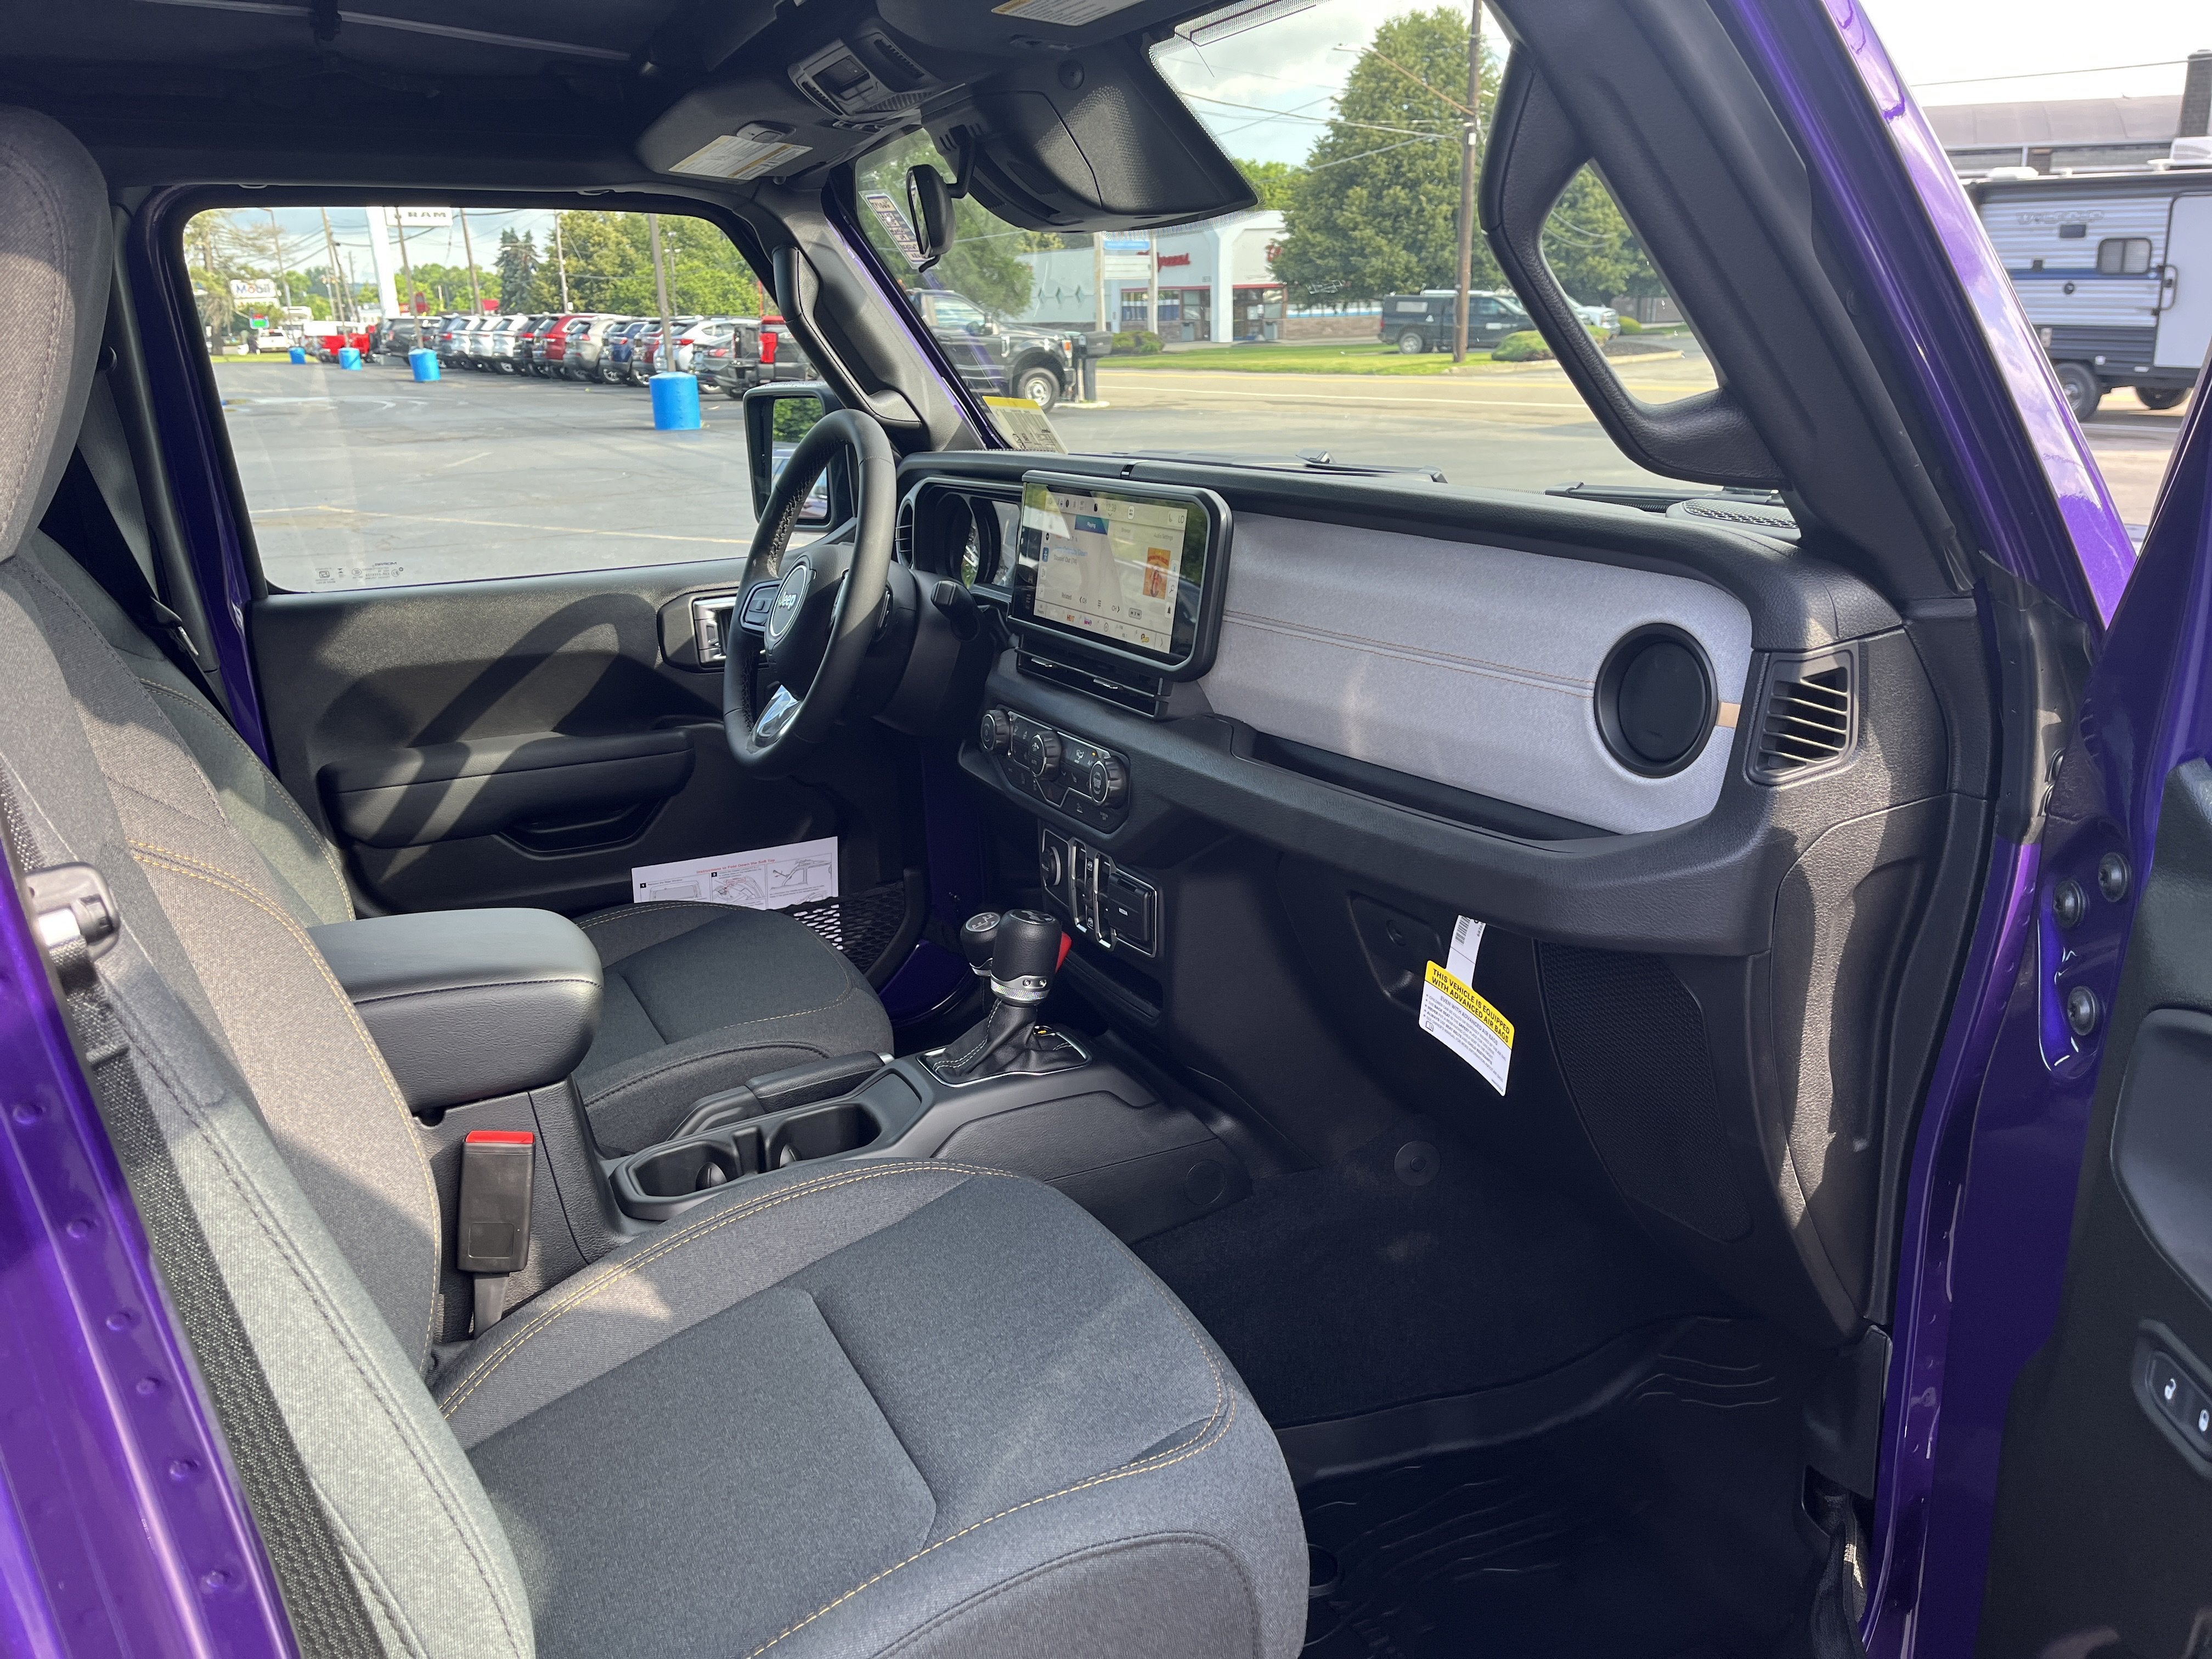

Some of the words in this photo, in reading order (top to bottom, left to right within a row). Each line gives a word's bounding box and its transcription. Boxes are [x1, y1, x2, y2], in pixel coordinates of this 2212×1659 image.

[236, 284, 270, 294] Mobil
[778, 591, 797, 610] Jeep
[1432, 977, 1448, 991] WITH
[1450, 989, 1482, 1018] ADVANCED
[1484, 1015, 1493, 1028] AIR
[1495, 1025, 1508, 1042] BAGS
[1433, 969, 1448, 983] THIS
[1449, 979, 1475, 1003] VEHICLE
[1476, 1000, 1481, 1008] IS
[1483, 1005, 1510, 1034] EQUIPPED
[1441, 996, 1451, 1006] EVEN
[1452, 1003, 1461, 1014] WITH
[1462, 1012, 1481, 1030] ADVANCED
[1489, 1034, 1498, 1045] BAGS
